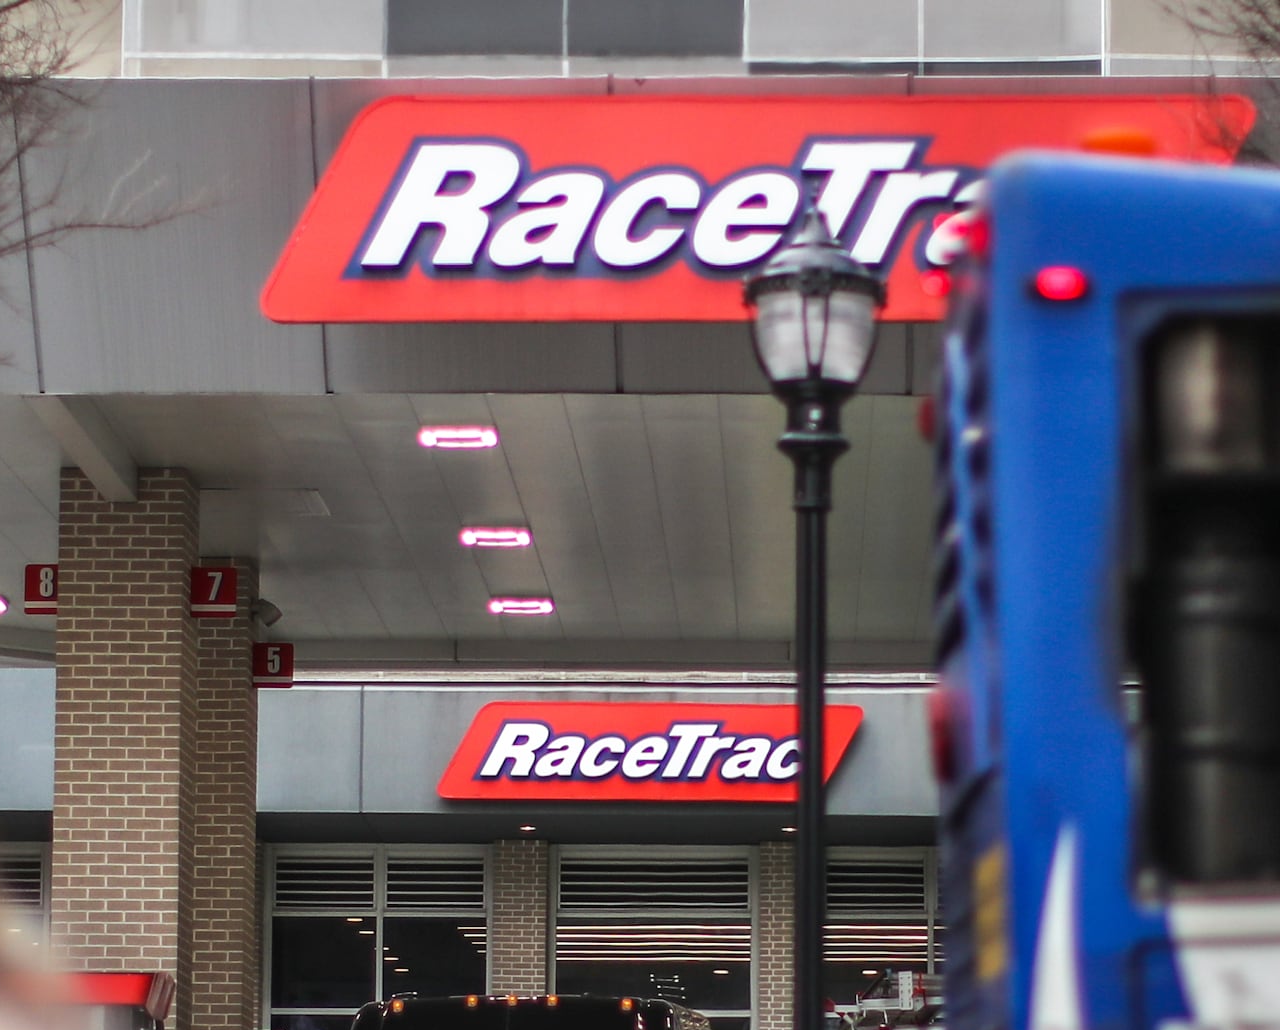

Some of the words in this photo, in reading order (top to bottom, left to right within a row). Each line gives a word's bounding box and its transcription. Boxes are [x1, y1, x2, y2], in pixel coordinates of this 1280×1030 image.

[38, 566, 55, 598] 8
[207, 571, 224, 601] 7
[266, 646, 282, 674] 5
[478, 722, 802, 780] RaceTrac
